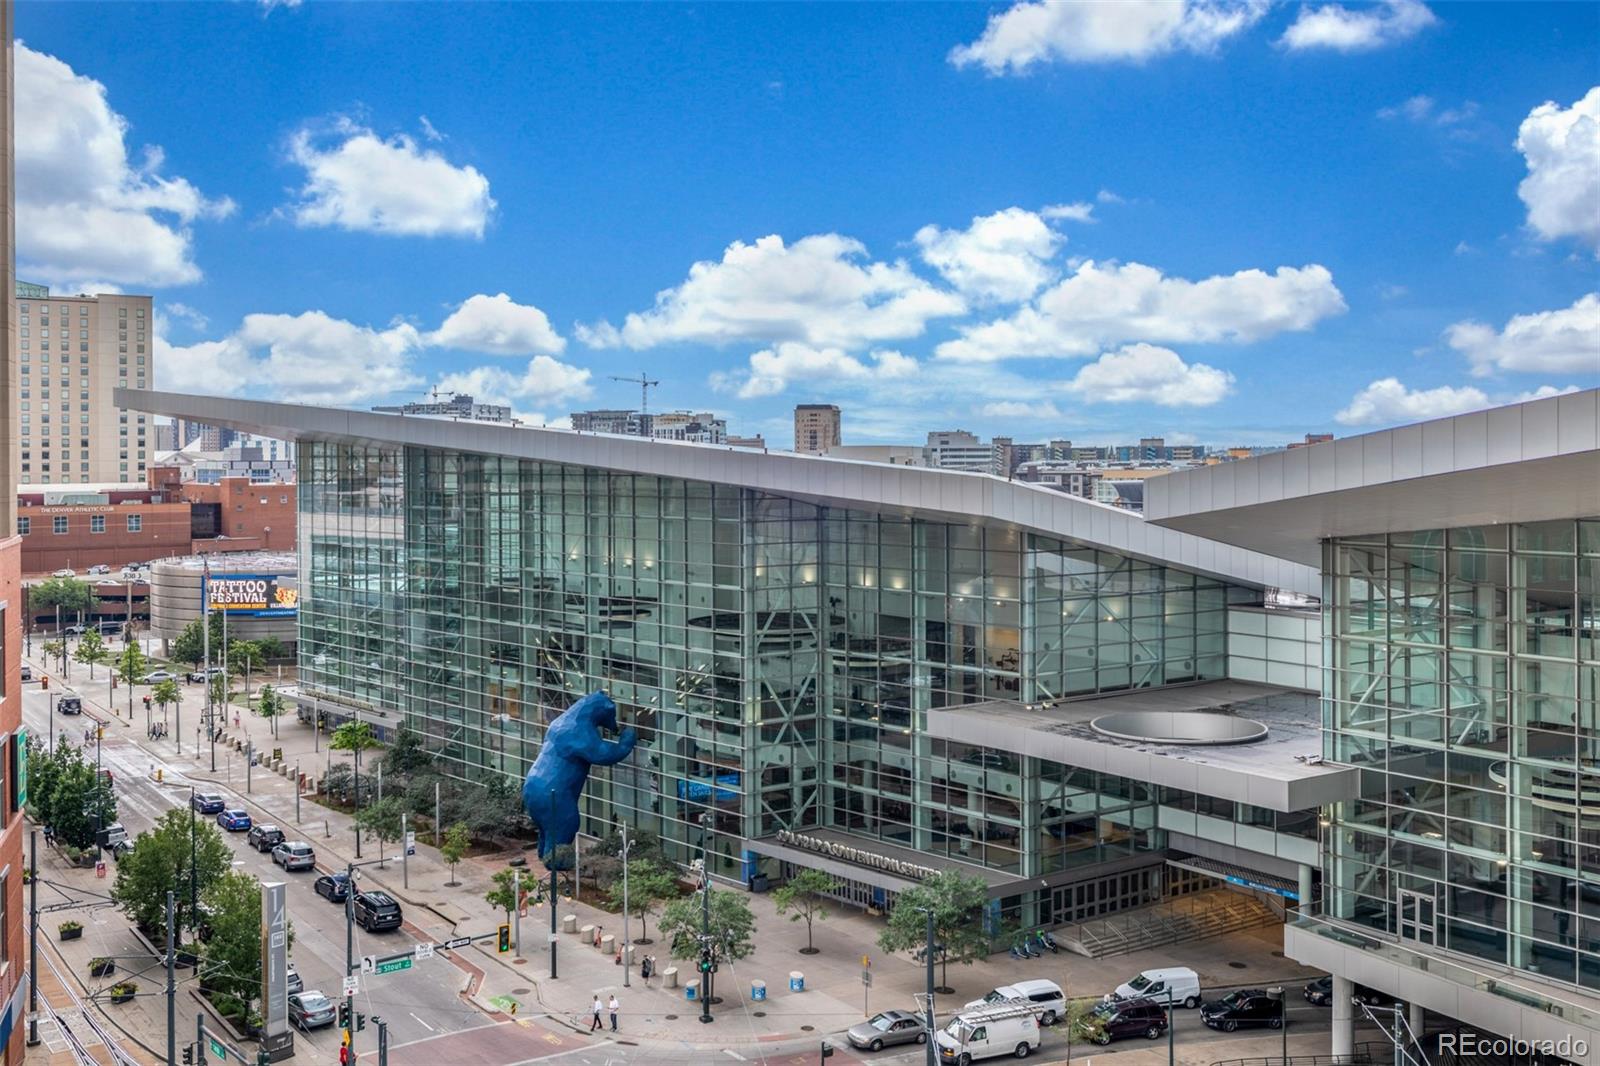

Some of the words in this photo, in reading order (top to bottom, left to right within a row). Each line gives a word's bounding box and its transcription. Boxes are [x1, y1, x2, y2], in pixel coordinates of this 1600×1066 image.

[210, 580, 267, 593] TATTOO
[210, 593, 267, 603] FESTIVAL
[776, 829, 835, 855] COLORADO
[832, 843, 899, 872] CONVENTION
[383, 962, 402, 972] Stout
